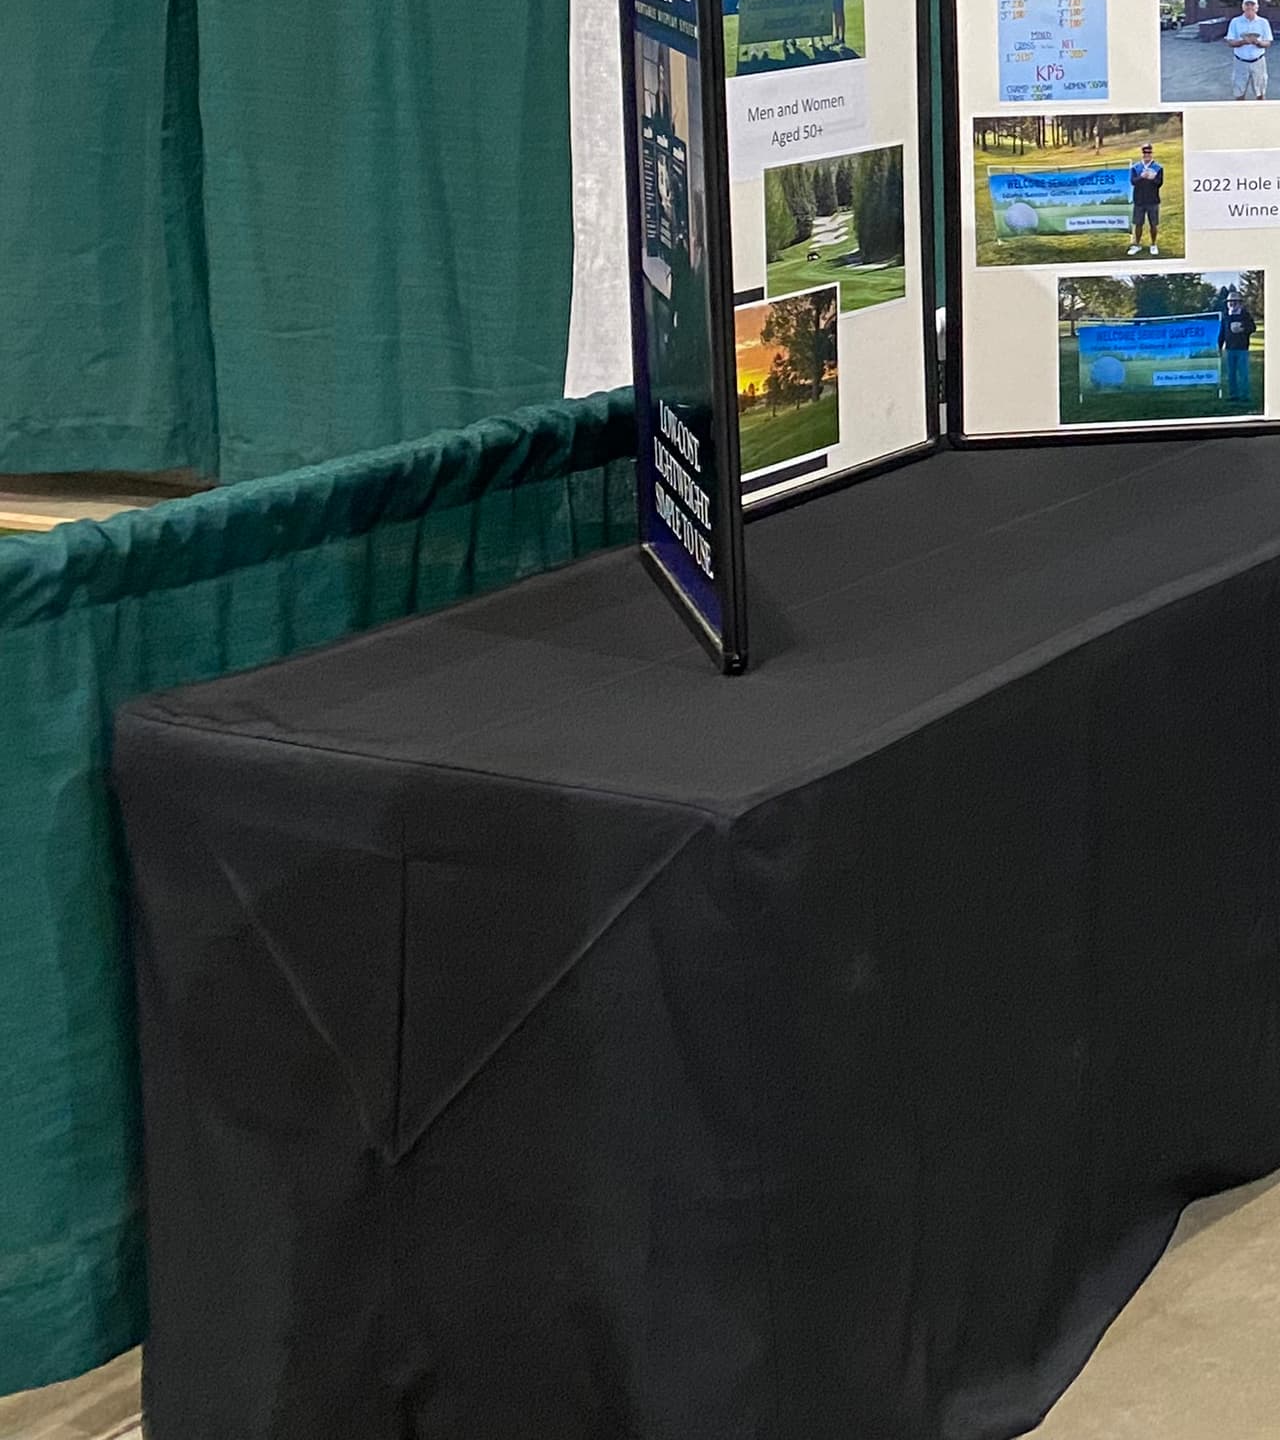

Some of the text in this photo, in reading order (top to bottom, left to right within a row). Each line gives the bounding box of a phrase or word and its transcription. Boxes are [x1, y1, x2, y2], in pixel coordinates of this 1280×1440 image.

[747, 95, 845, 122] Men and Women
[771, 123, 823, 148] Aged 50+
[1193, 178, 1231, 192] 2022
[1236, 177, 1272, 191] Hole
[681, 513, 694, 555] TO
